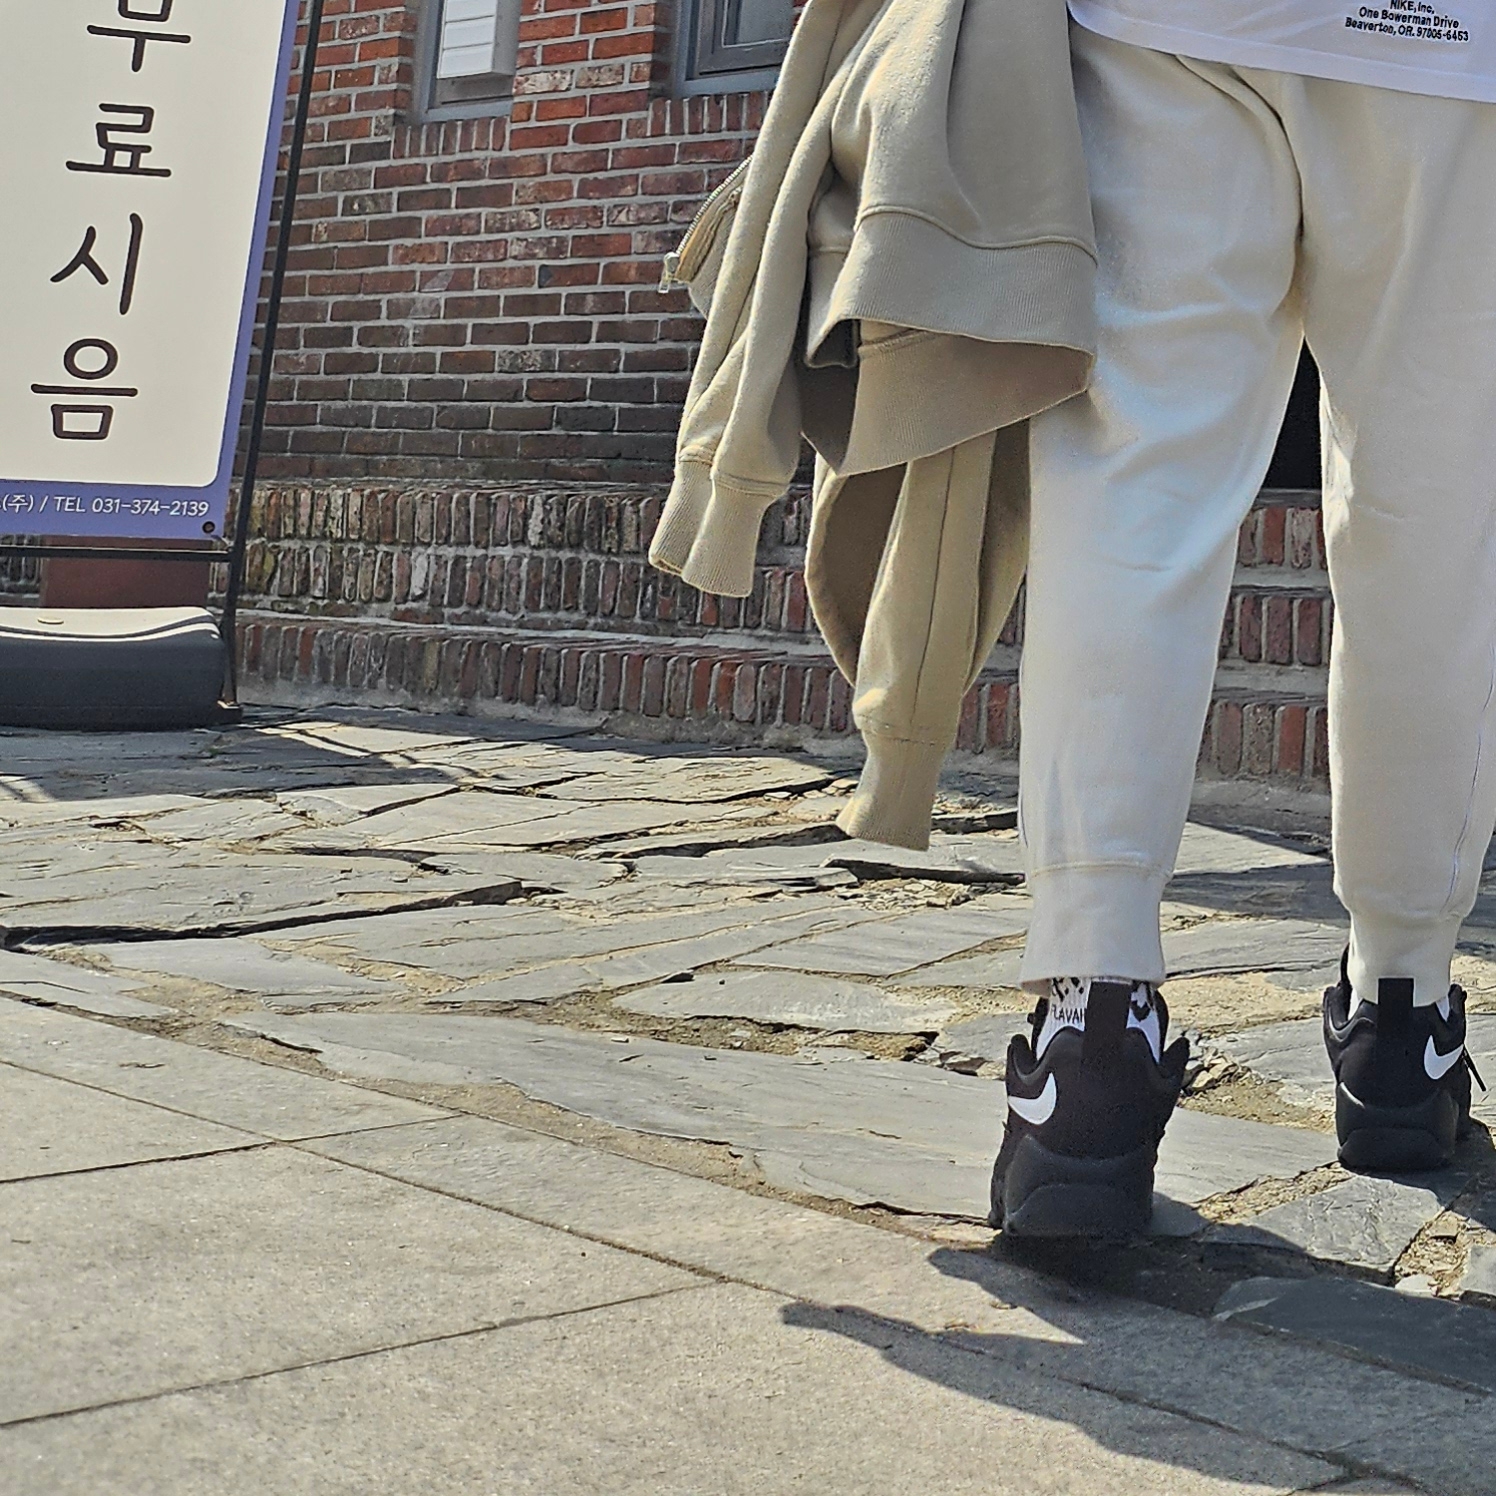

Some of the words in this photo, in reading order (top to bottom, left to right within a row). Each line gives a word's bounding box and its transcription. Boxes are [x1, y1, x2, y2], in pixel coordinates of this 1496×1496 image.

[1345, 16, 1396, 35] Beaverton,
[1398, 24, 1414, 37] OR.
[1359, 6, 1379, 19] One
[1381, 9, 1432, 26] Bowerman
[1433, 15, 1459, 28] Drive
[0, 493, 34, 514] (주)
[54, 496, 86, 513] TEL
[92, 498, 209, 517] 031-374-2139
